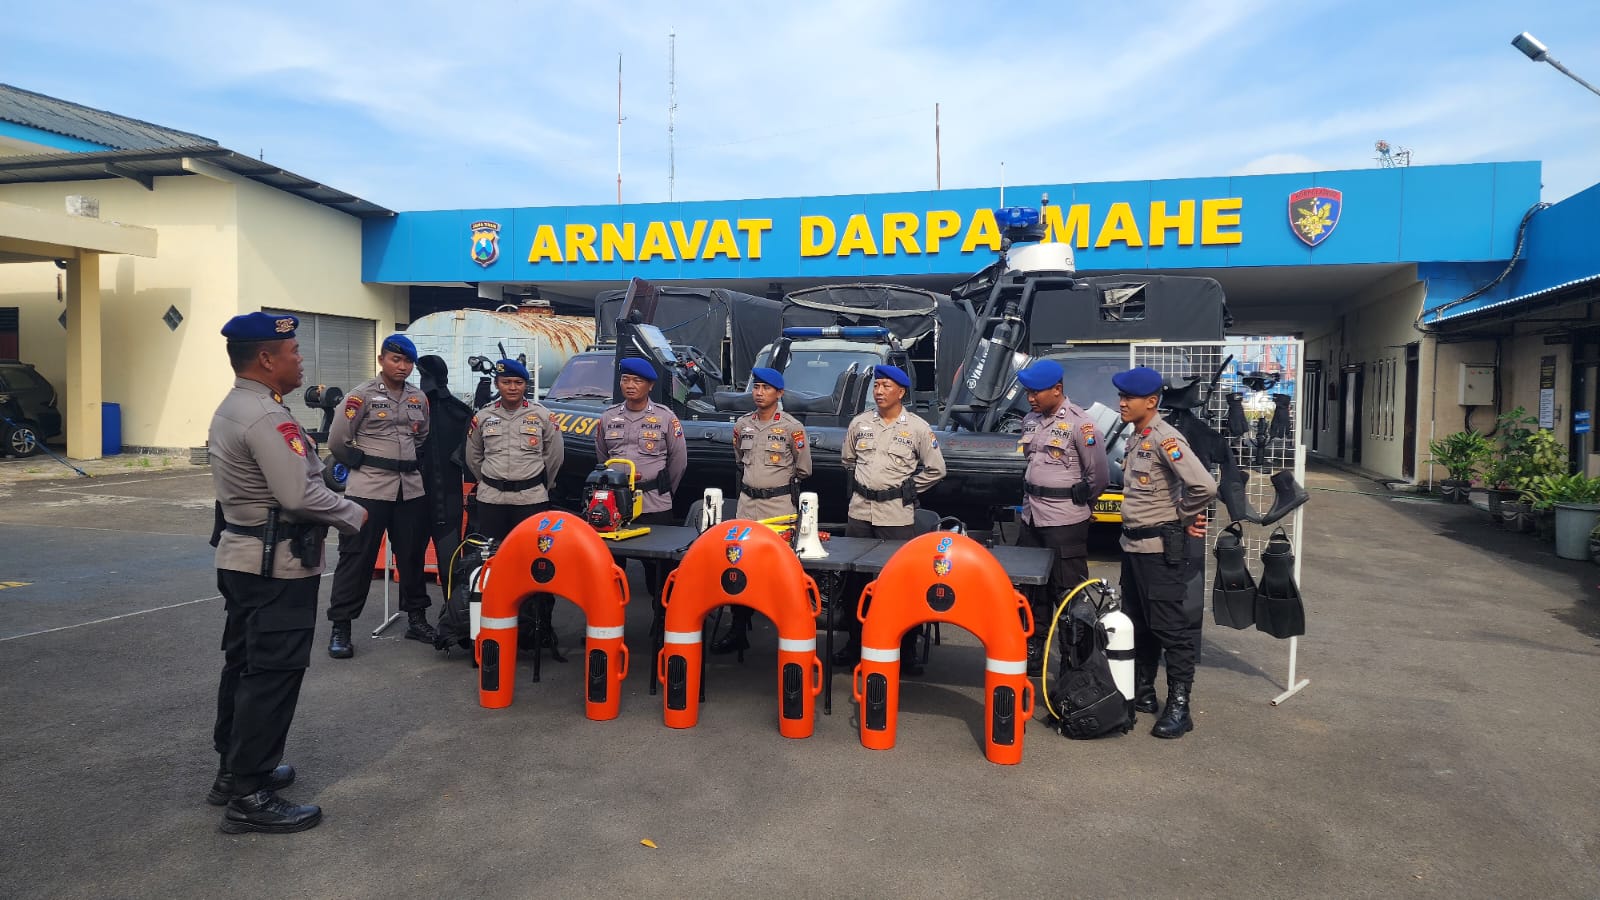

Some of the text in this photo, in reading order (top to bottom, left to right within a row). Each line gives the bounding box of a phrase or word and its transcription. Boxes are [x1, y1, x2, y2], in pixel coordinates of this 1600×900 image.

[528, 197, 1243, 264] ARNAVAT DARPA MAHE
[892, 436, 913, 445] POLRI
[1050, 429, 1070, 440] POLRI
[936, 537, 953, 553] 8
